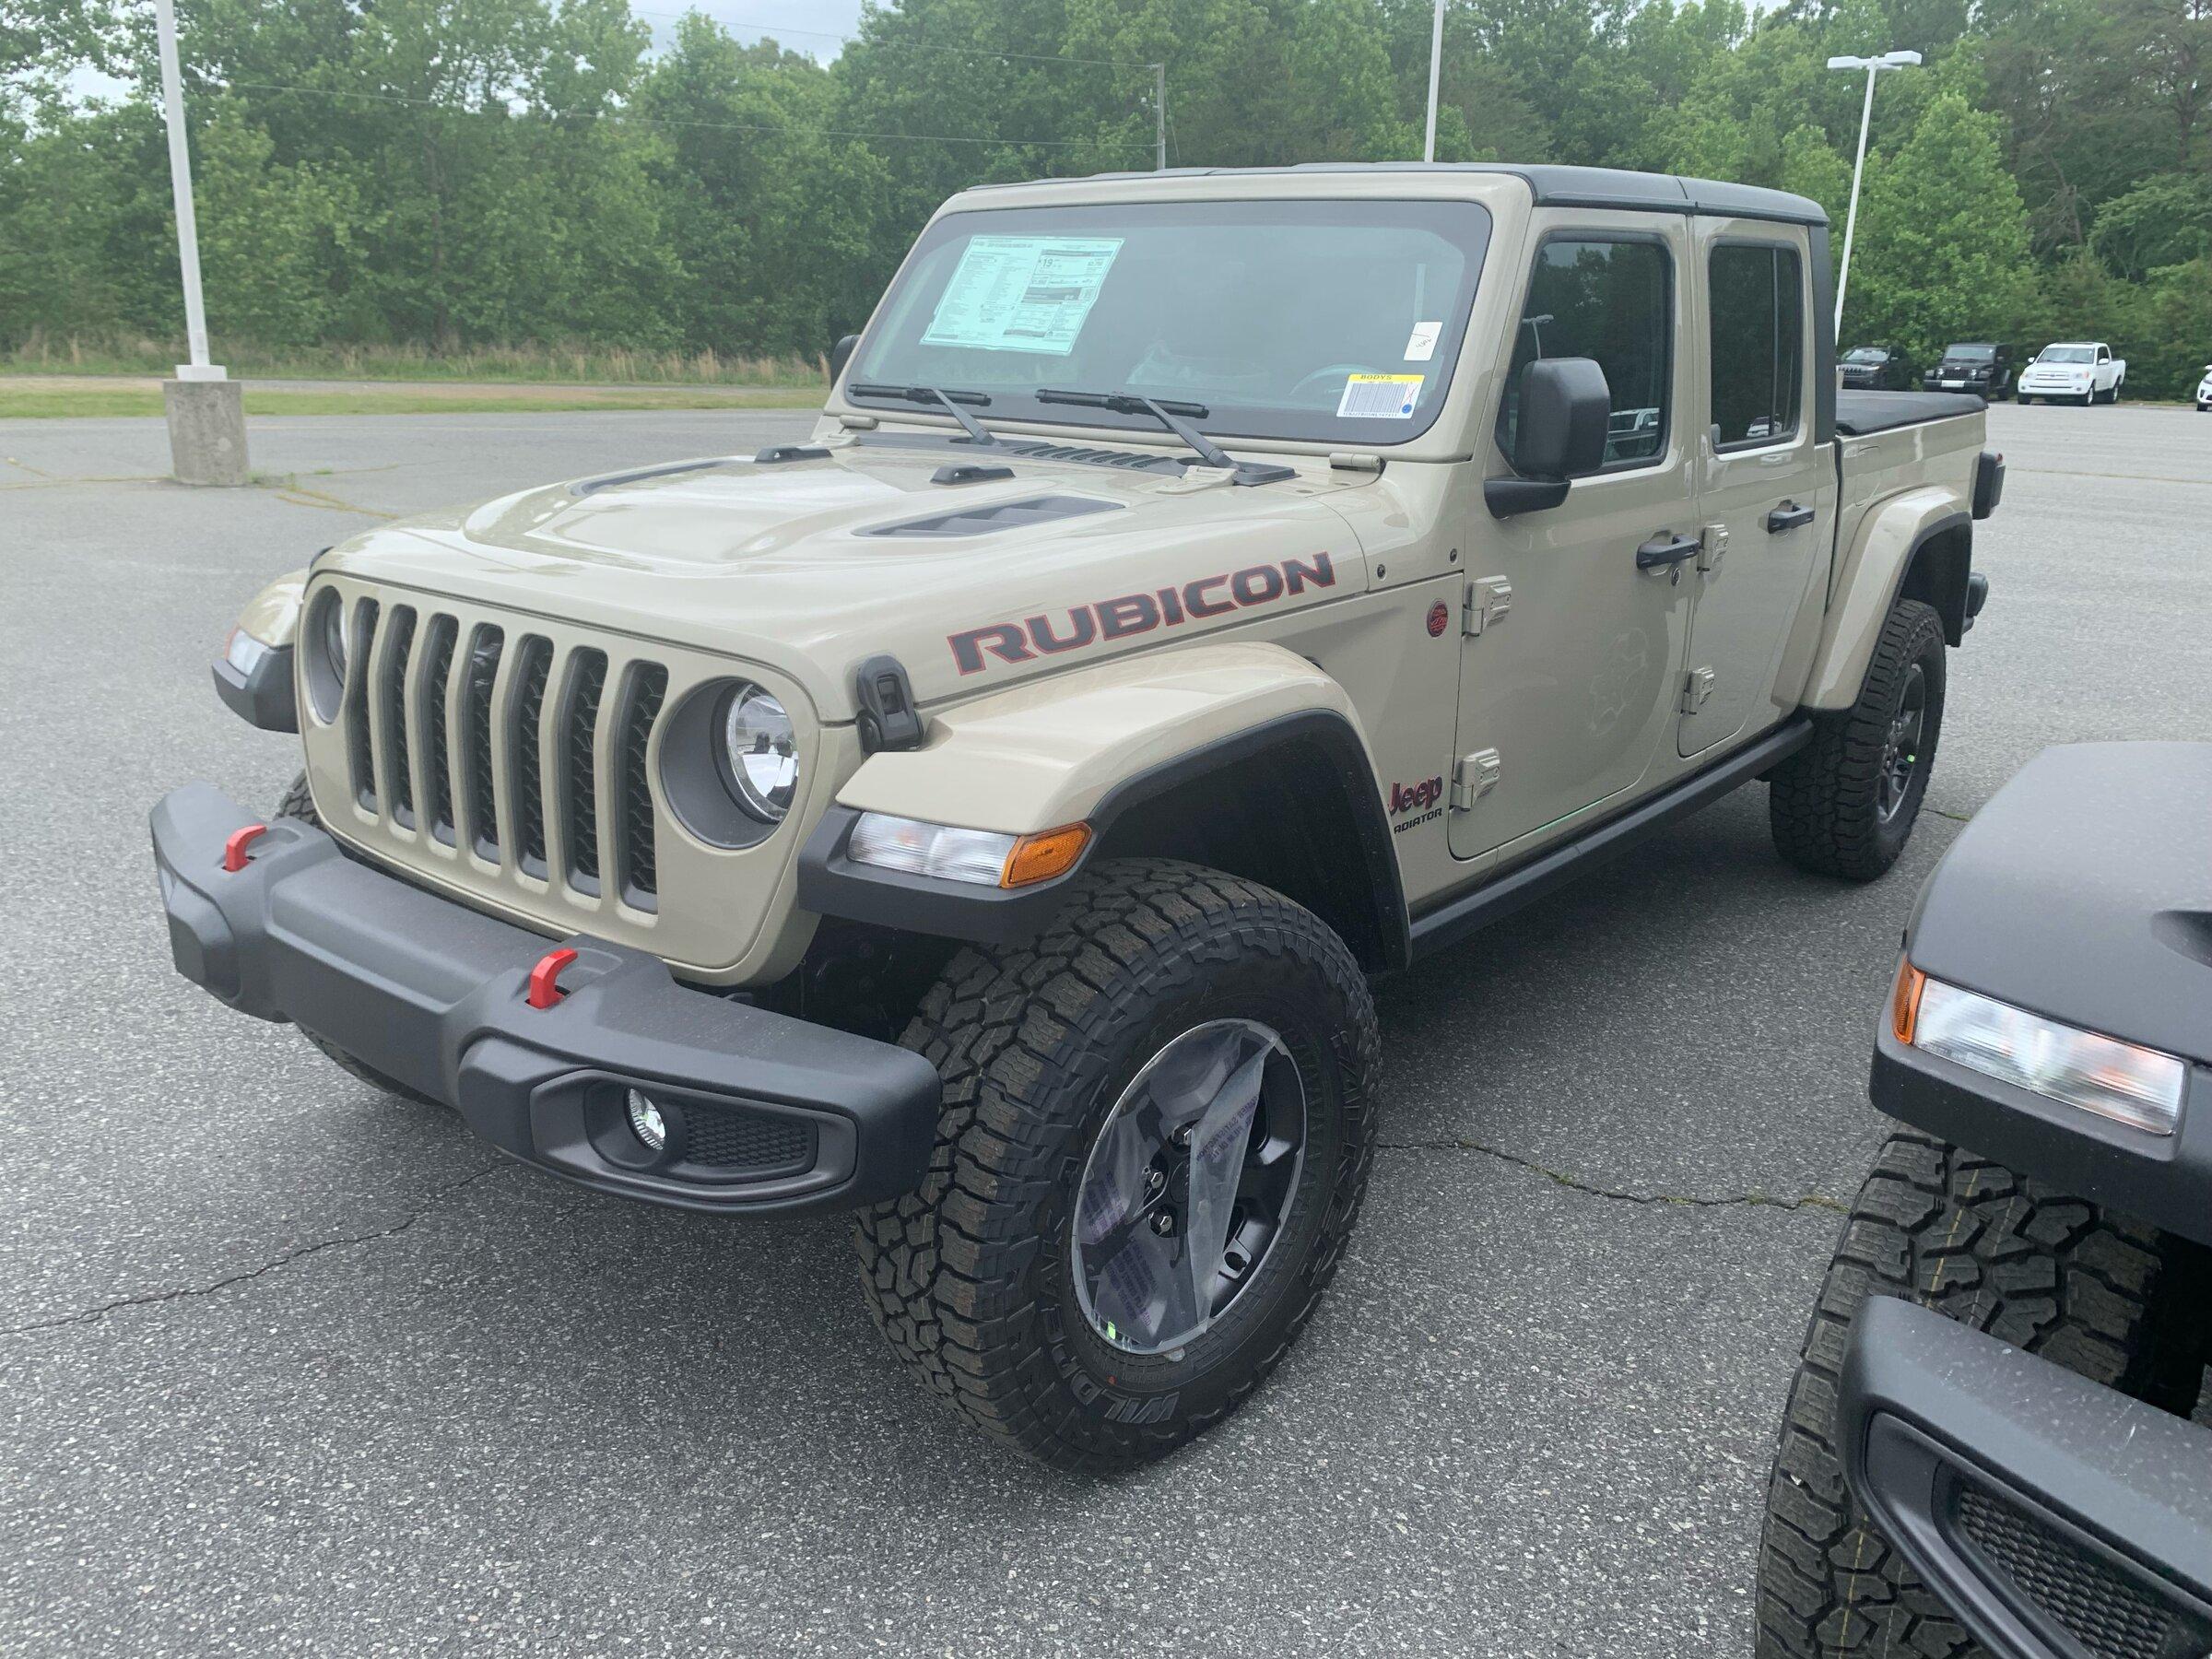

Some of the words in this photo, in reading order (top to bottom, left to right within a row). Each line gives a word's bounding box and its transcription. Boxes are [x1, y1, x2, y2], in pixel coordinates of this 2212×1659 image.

[947, 551, 1336, 677] RUBICON
[1388, 776, 1443, 818] Jeep
[1393, 806, 1442, 835] ADIATOR
